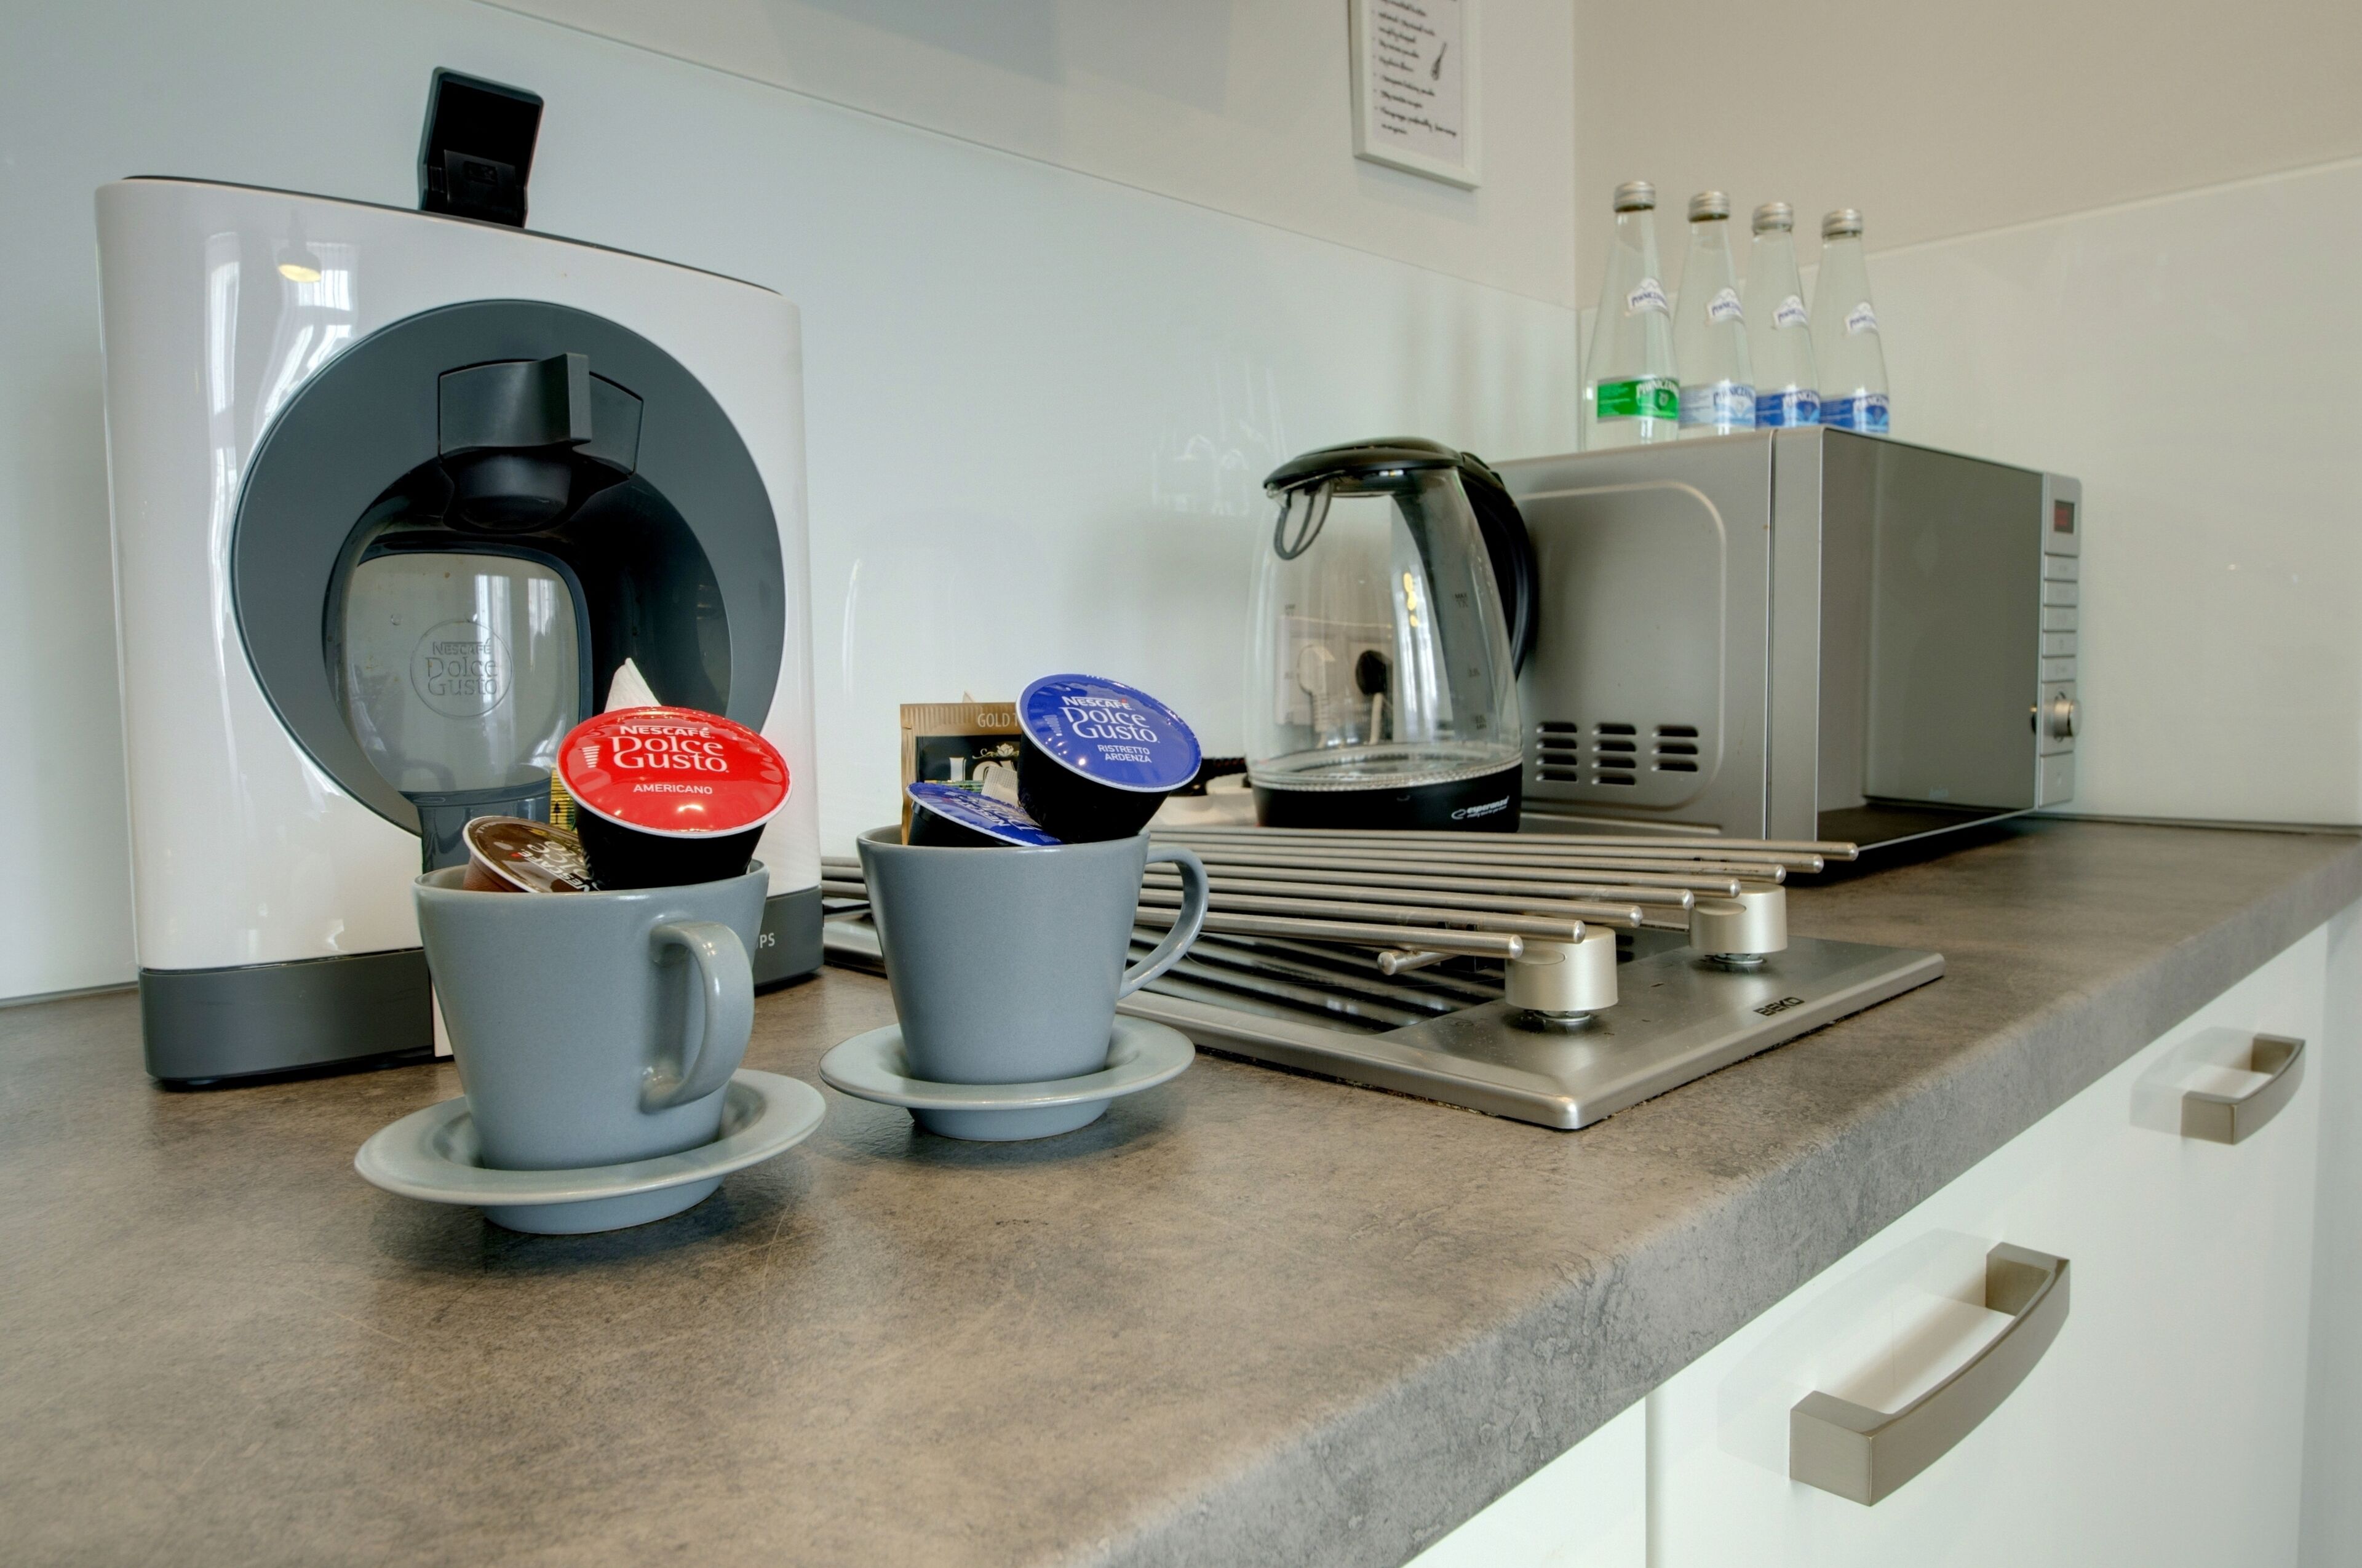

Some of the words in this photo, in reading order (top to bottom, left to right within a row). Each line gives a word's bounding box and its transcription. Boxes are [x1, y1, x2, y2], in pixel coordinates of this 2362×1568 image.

[432, 639, 491, 655] NESCAFÉ
[425, 656, 498, 678] Dolce
[428, 676, 497, 696] Gusto
[1062, 696, 1131, 710] NESCAFÉ
[977, 713, 1010, 728] GOLD
[1060, 707, 1147, 728] Dolce
[620, 725, 711, 739] NESCAFÉ
[1072, 720, 1158, 743] Gusto
[608, 735, 724, 757] Dolce
[1097, 744, 1150, 755] RISTRETTO
[613, 750, 728, 773] Gusto
[1105, 752, 1152, 763] ARDENZA
[633, 783, 713, 795] AMERICANO
[1752, 996, 1805, 1017] BEKO
